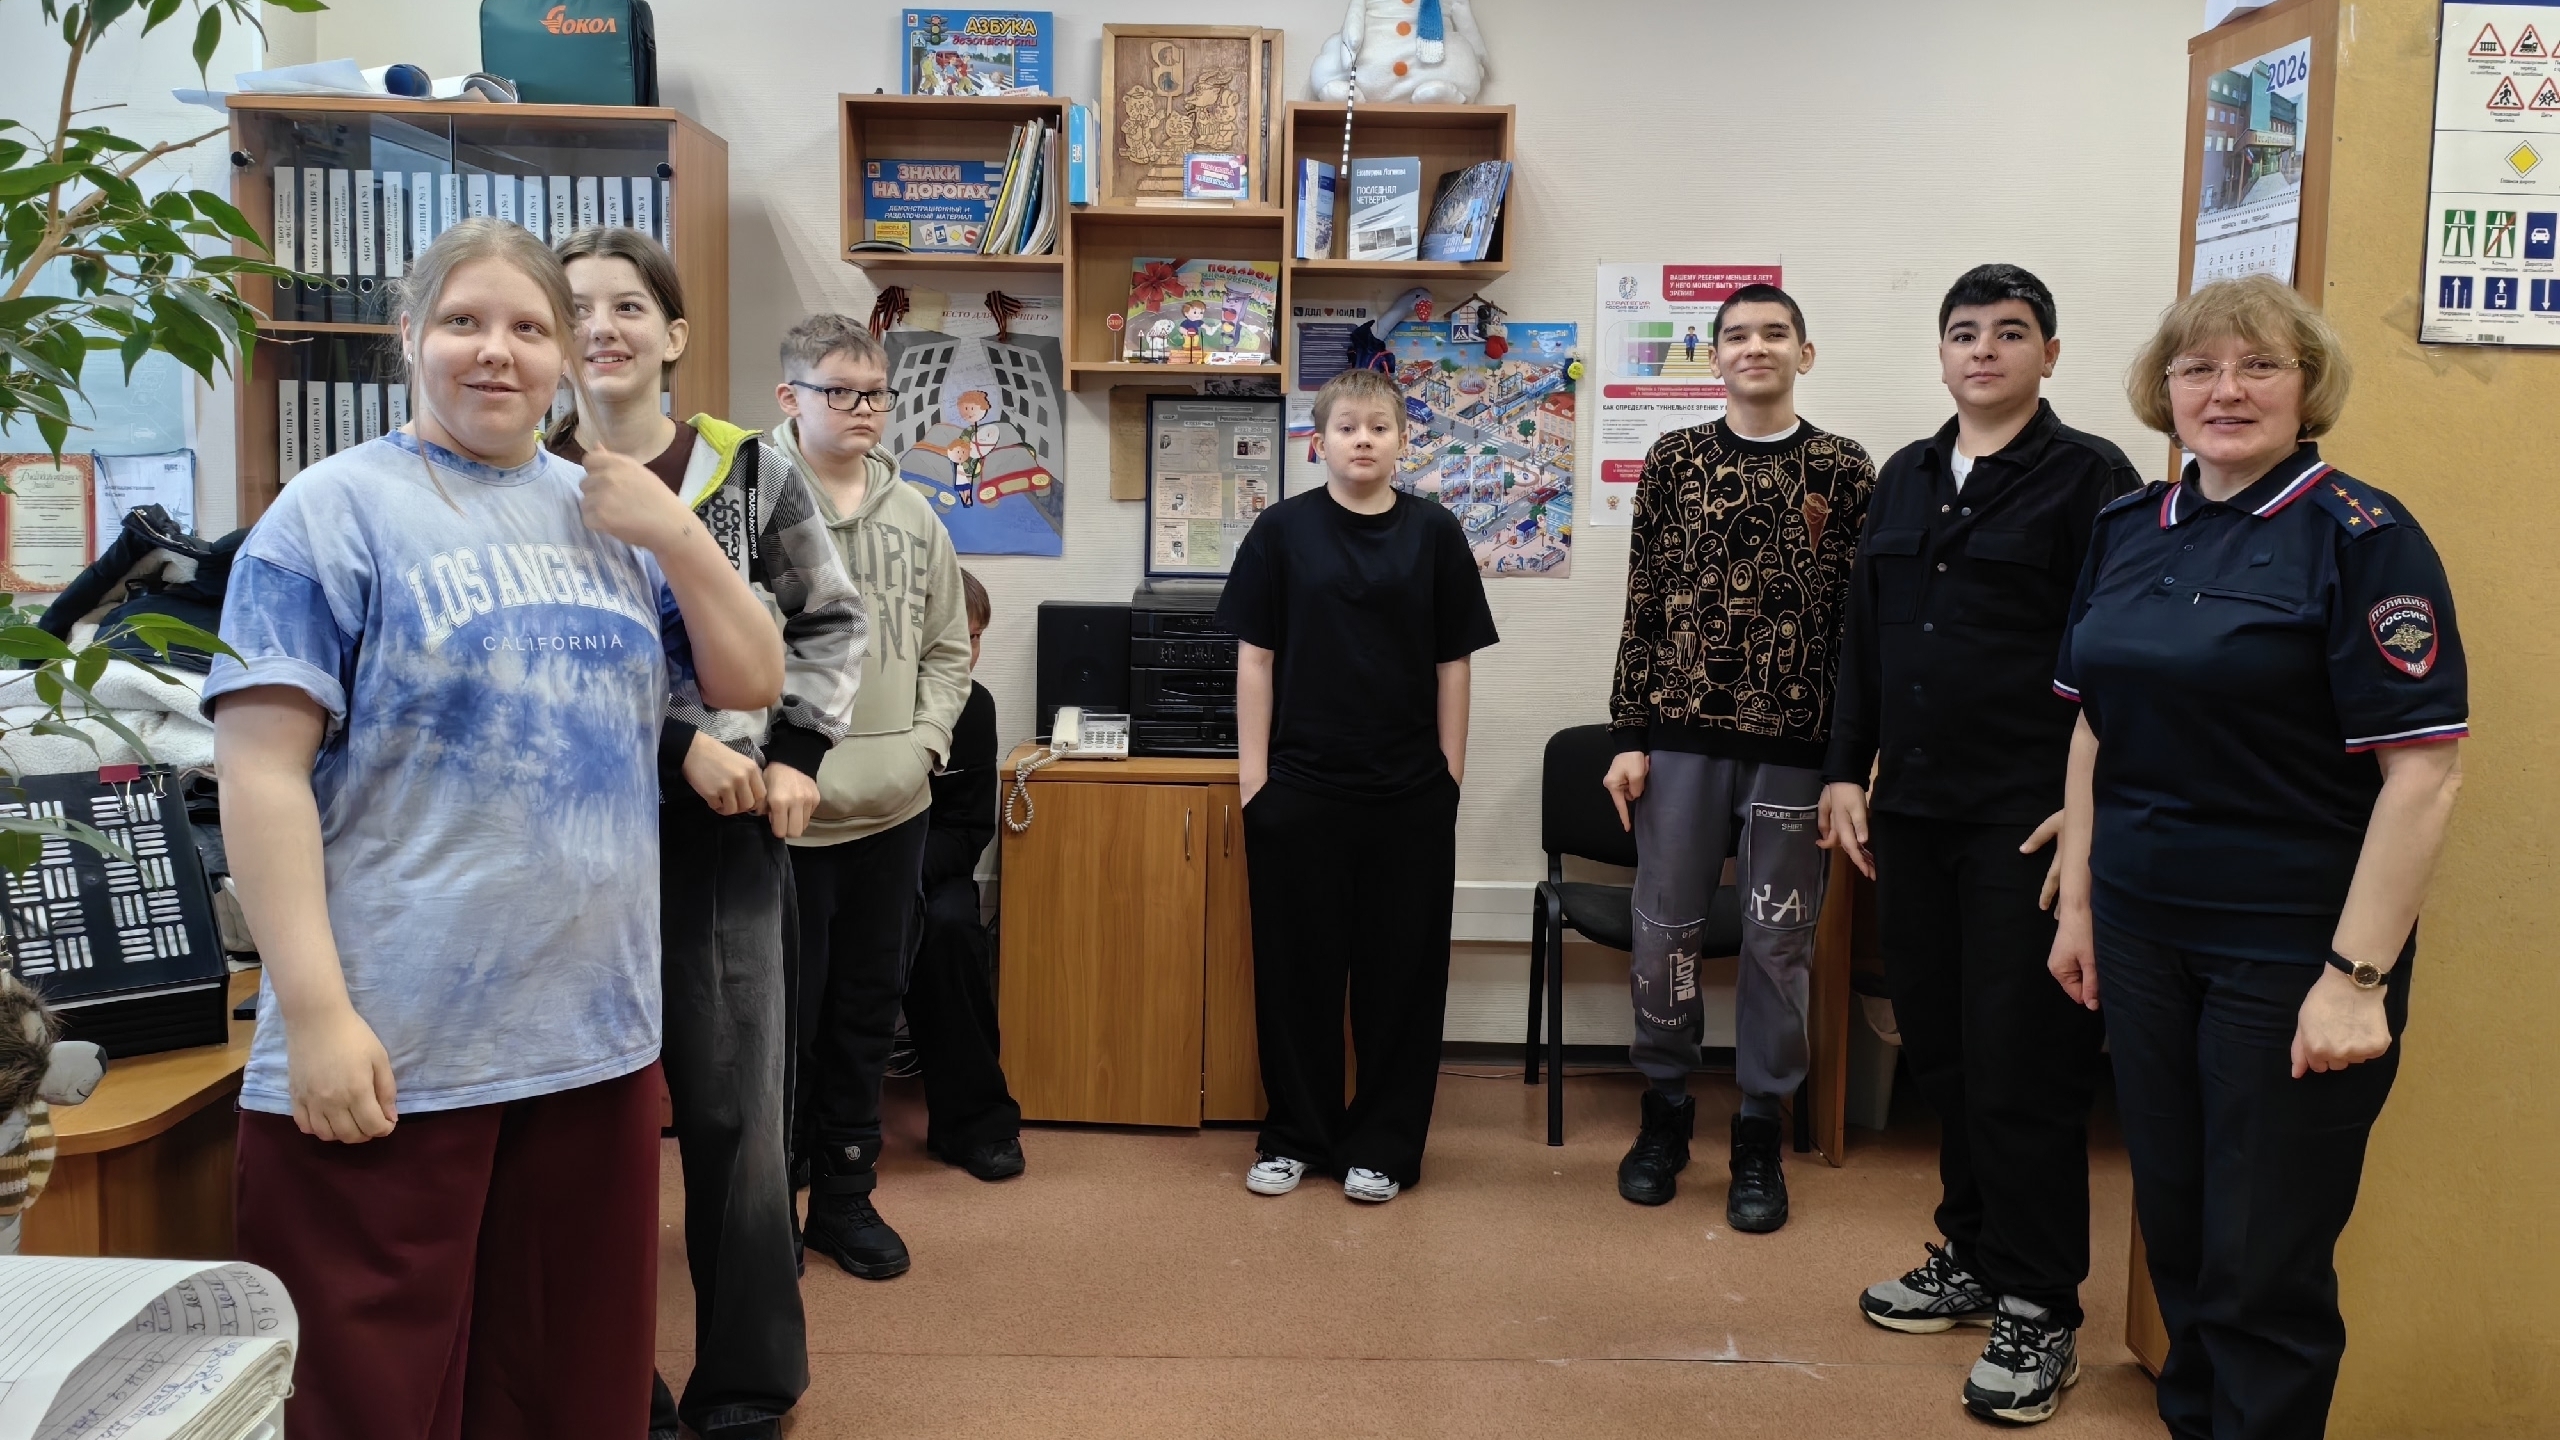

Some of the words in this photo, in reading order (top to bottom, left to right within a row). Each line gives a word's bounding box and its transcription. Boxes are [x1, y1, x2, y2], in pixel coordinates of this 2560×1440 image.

[965, 17, 1037, 36] АЗБУКА
[2266, 51, 2307, 92] 2026
[897, 164, 962, 182] ЗНАКИ
[1356, 169, 1382, 177] Екатерина
[872, 181, 902, 198] НА
[903, 181, 991, 201] ДОРОГАХ
[1356, 186, 1397, 195] ПОСЛЕДНЯЯ
[888, 205, 962, 213] ДЕМОНСТРАЦИОННЫЙ
[1356, 196, 1389, 205] ЧЕТВЕРТЬ
[310, 191, 318, 241] ГИМНАЗИЯ
[361, 202, 369, 233] ЛИЦЕЙ
[418, 203, 426, 236] ЛИЦЕЙ
[2209, 257, 2214, 266] 2
[2219, 255, 2224, 264] 3
[2240, 251, 2244, 260] 5
[2250, 249, 2255, 257] 6
[2261, 247, 2265, 255] 7
[2227, 266, 2233, 275] 11
[2237, 264, 2244, 273] 12
[2258, 260, 2265, 268] 14
[2269, 257, 2276, 266] 15
[1208, 263, 1273, 283] ПОДАРОК
[342, 399, 349, 407] 12
[393, 400, 401, 408] 15
[313, 419, 321, 441] СОШ
[342, 420, 350, 442] СОШ
[286, 436, 294, 462] МБОУ
[748, 488, 757, 517] house
[405, 546, 494, 654] LOS
[2371, 597, 2429, 622] ПОЛИЦИЯ
[2379, 610, 2428, 633] РОССИЯ
[483, 634, 624, 651] CALIFORNIA
[2406, 660, 2428, 674] МВД
[1756, 809, 1791, 818] BOWLER
[1782, 823, 1803, 831] SHIRT
